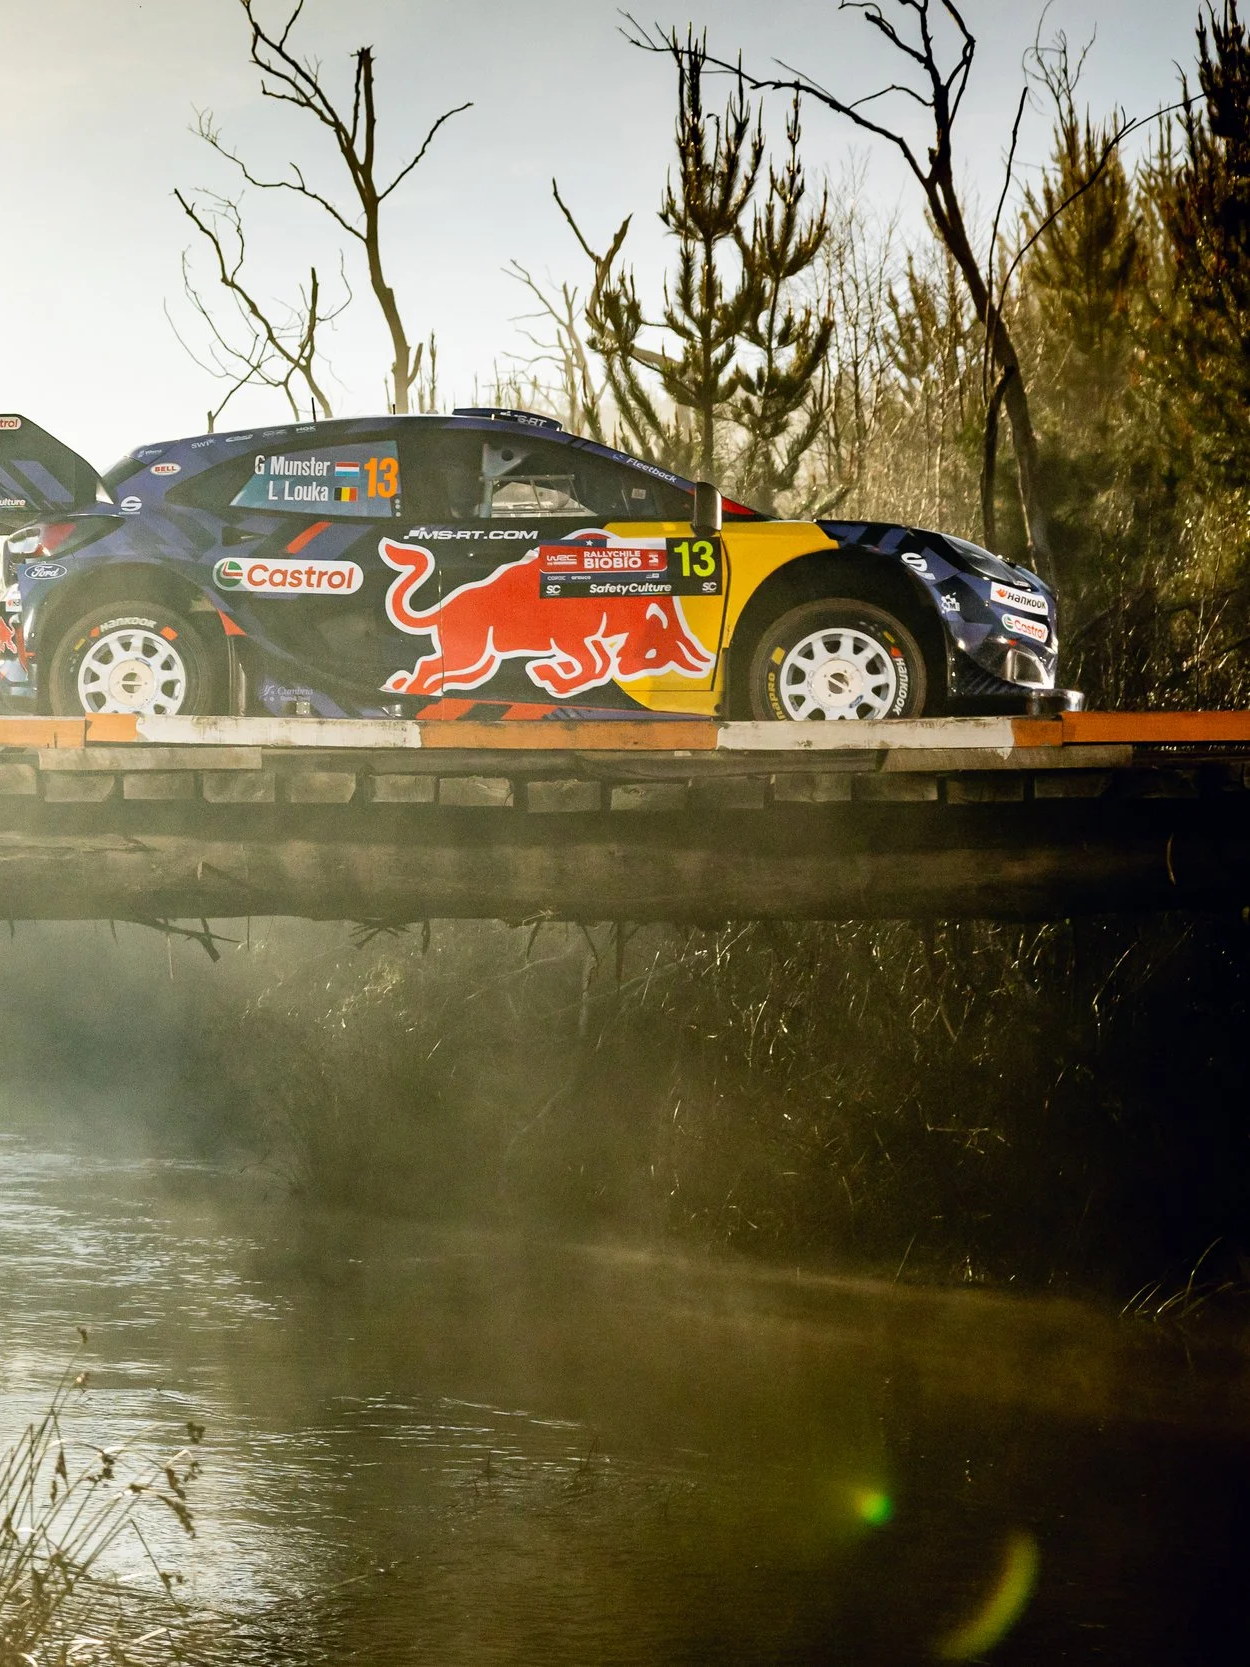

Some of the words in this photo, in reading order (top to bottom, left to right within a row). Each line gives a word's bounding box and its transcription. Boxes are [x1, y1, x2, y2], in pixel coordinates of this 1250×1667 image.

[255, 455, 266, 475] G
[270, 456, 331, 476] Munster
[626, 457, 678, 483] Fleetback
[364, 457, 399, 498] 13
[268, 481, 278, 500] L
[284, 481, 329, 501] Louka
[417, 530, 539, 540] MS-RT.COM
[584, 550, 641, 559] RALLYCHILE
[674, 540, 716, 577] 13
[31, 564, 60, 577] Ford
[247, 564, 355, 589] Castrol
[546, 585, 561, 594] SC
[589, 582, 672, 595] SafetyCulture
[702, 582, 717, 592] SC
[1014, 619, 1046, 640] Castrol
